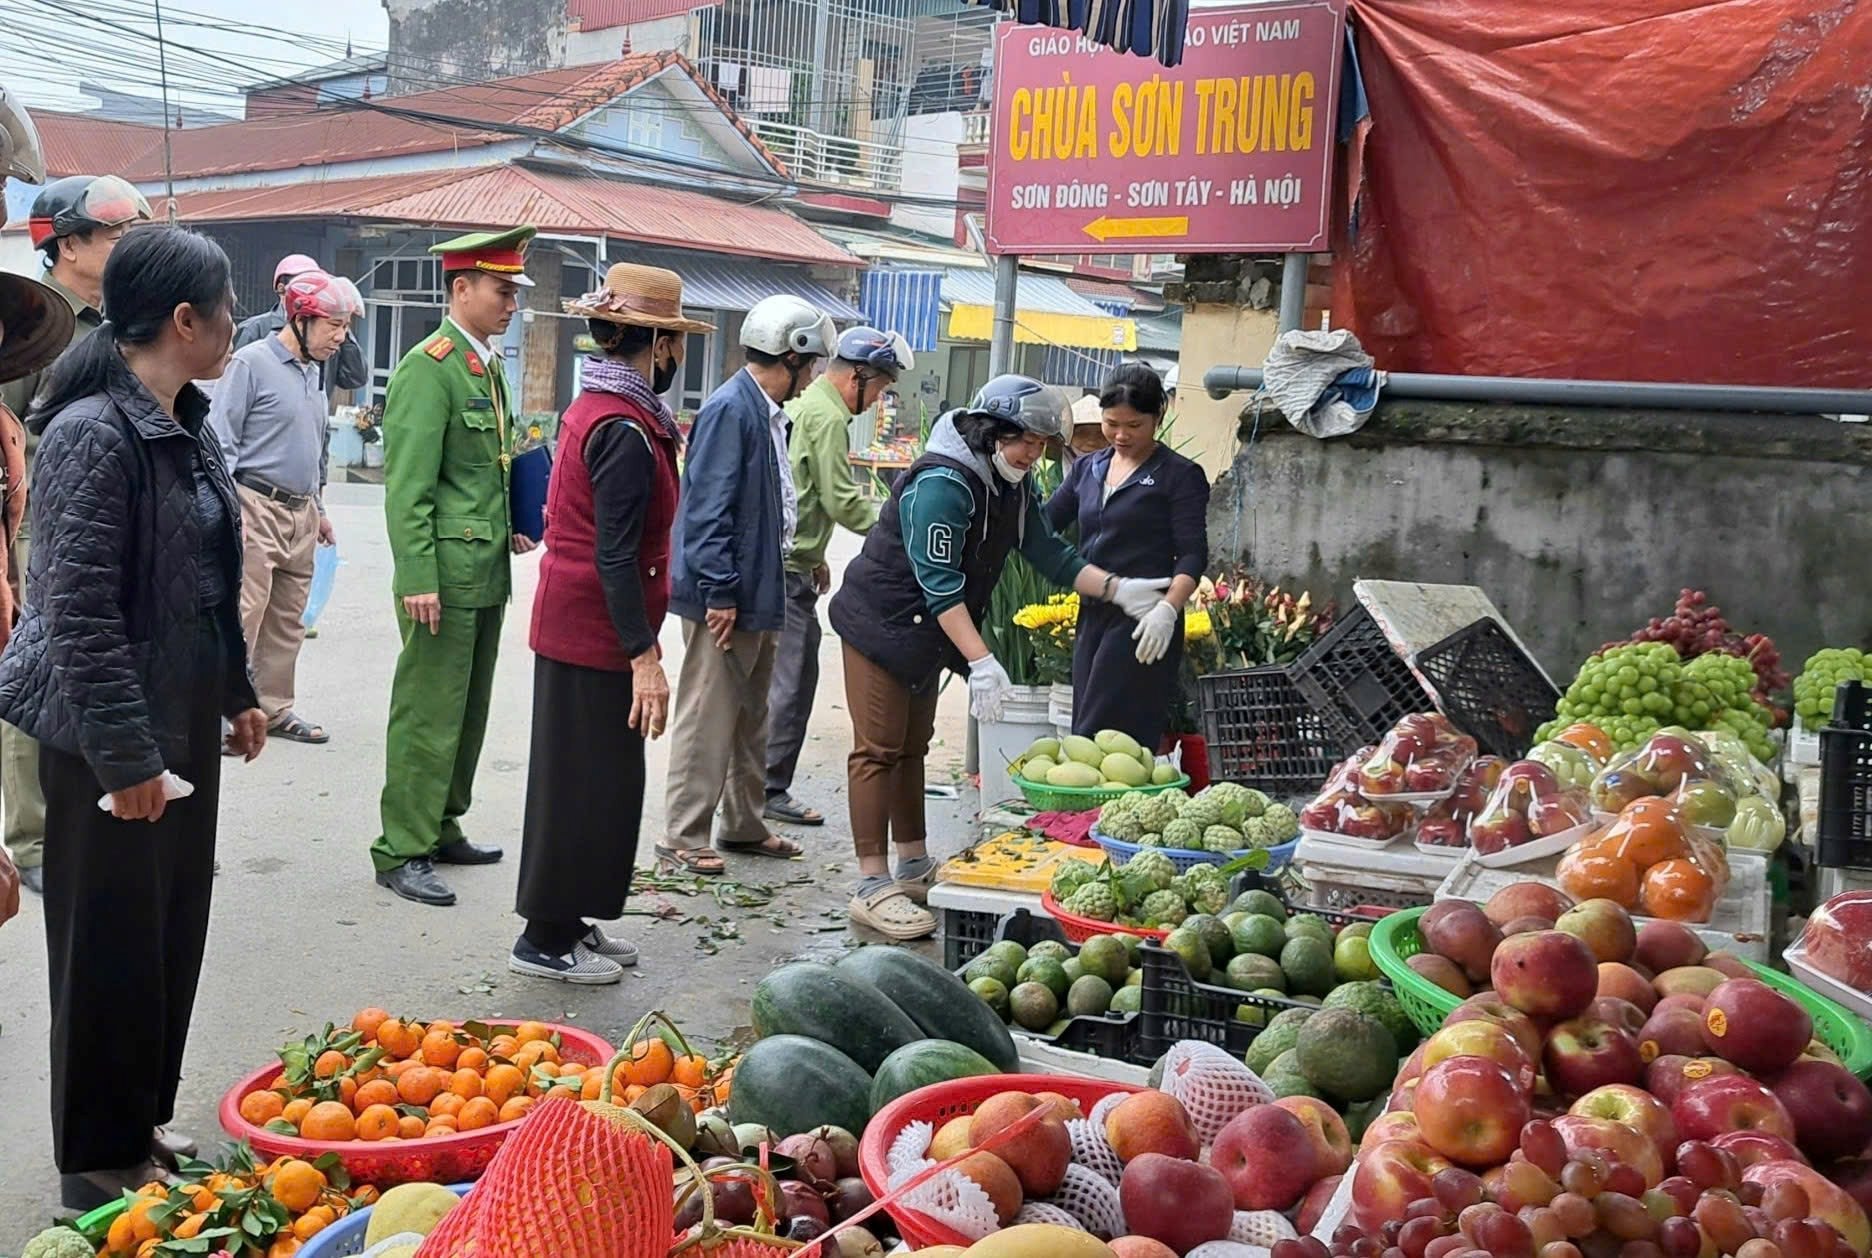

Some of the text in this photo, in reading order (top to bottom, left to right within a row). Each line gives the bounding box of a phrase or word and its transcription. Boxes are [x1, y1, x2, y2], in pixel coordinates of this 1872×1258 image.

[1029, 32, 1070, 57] GIÁO
[1211, 19, 1250, 48] VIỆT
[1256, 19, 1300, 42] NAM
[1009, 71, 1315, 161] CHÙA SƠN TRUNG
[1011, 183, 1051, 209] SƠN
[1055, 178, 1109, 209] ĐÔNG
[1127, 180, 1169, 207] SƠN
[1175, 175, 1212, 206] TÂY
[1229, 174, 1258, 205] HÀ
[1264, 172, 1302, 209] NỘI
[927, 522, 952, 564] G
